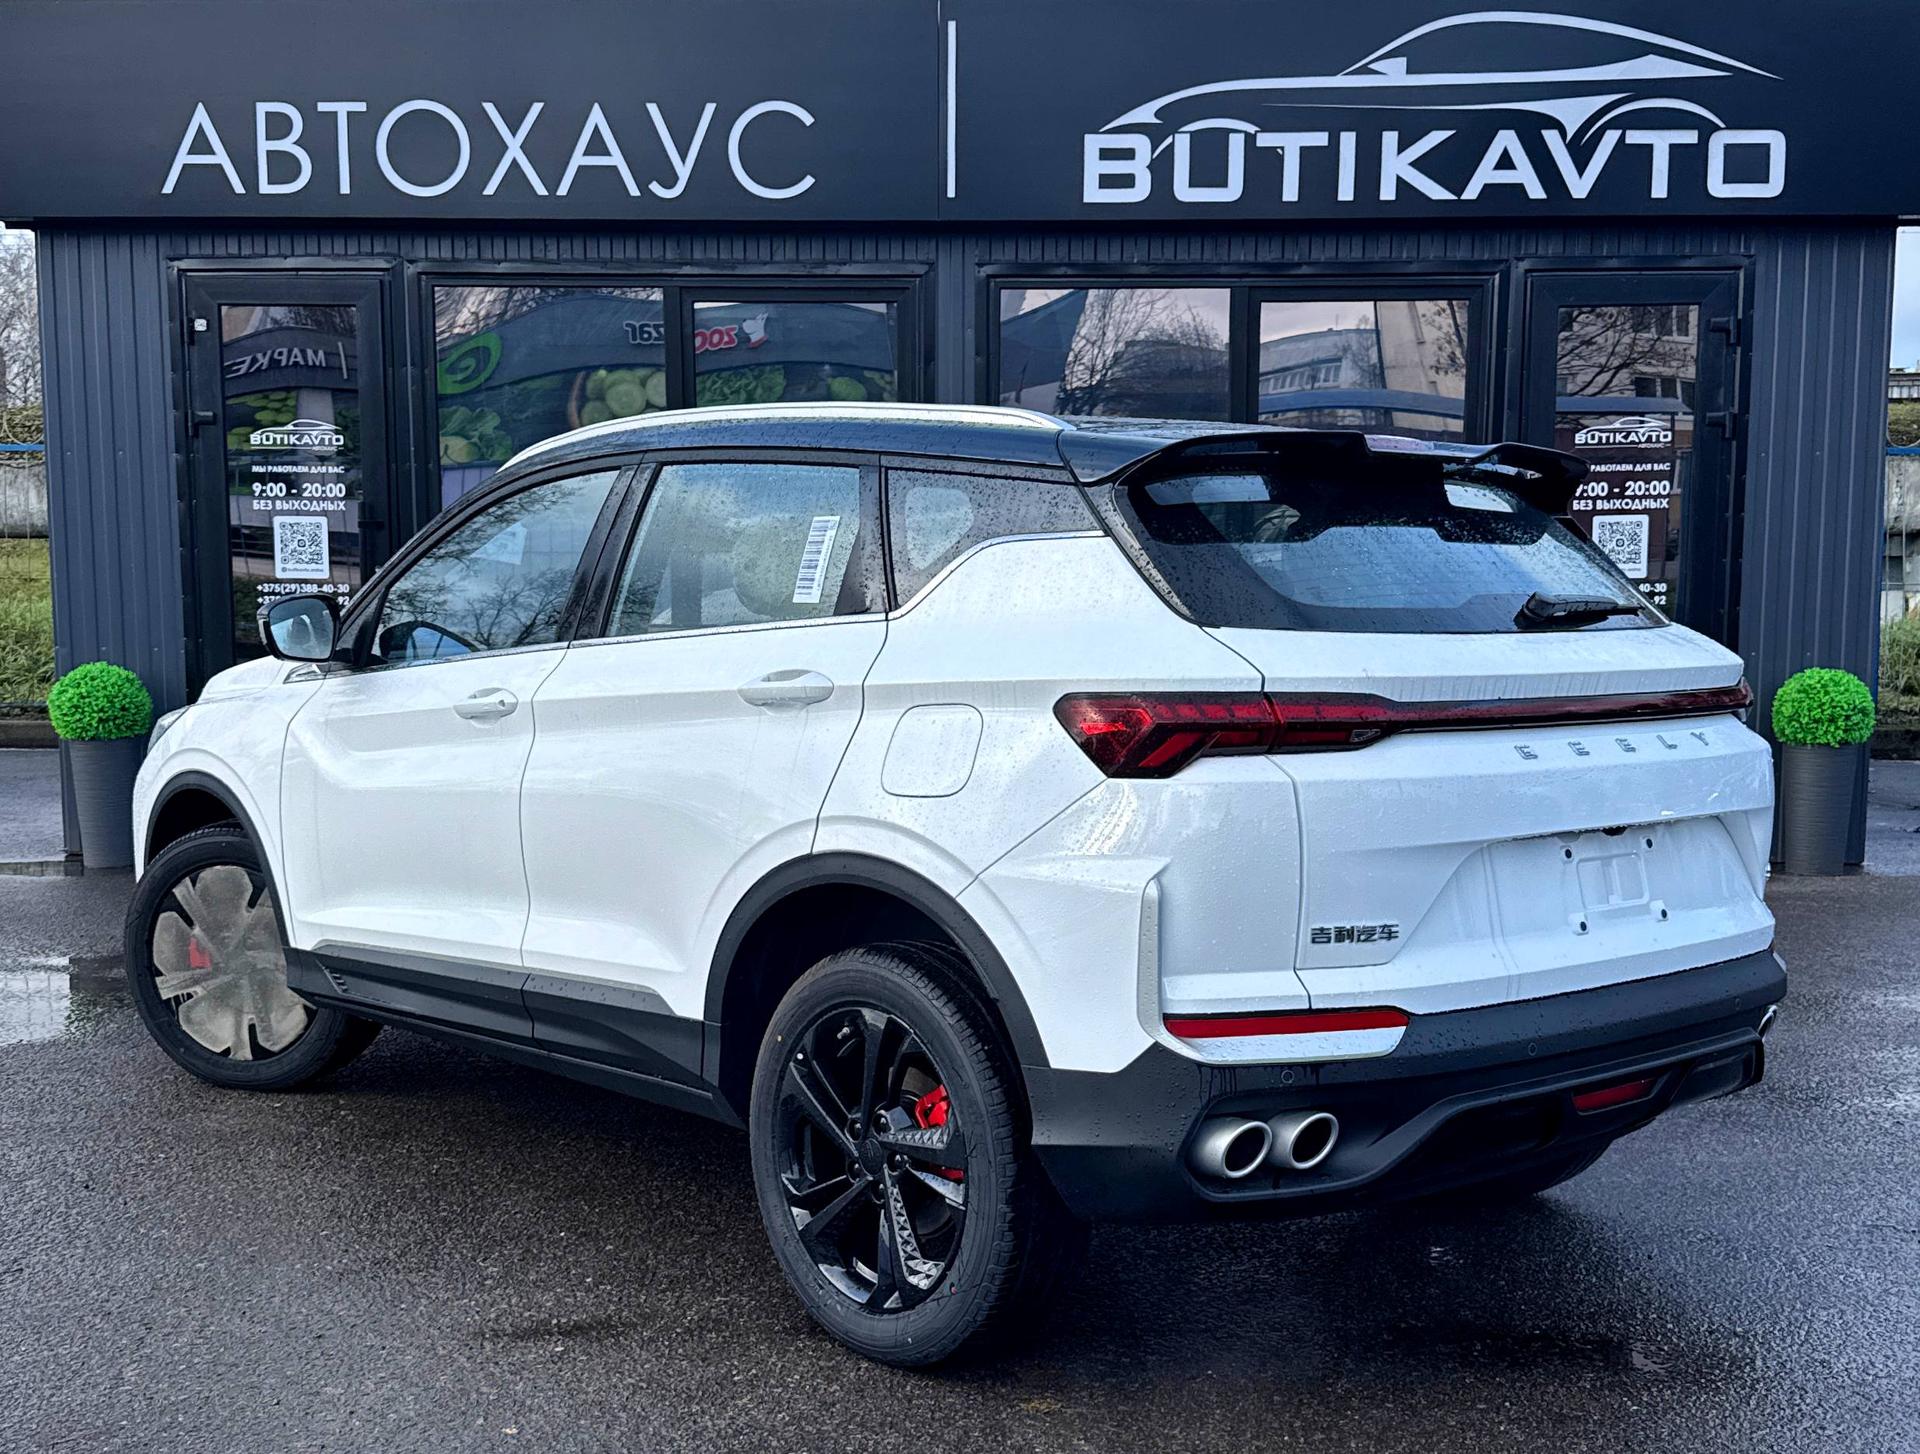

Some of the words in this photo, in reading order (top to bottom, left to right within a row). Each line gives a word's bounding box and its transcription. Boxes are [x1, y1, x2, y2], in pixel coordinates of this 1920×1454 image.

[161, 99, 816, 200] АВТОХАУС
[1083, 129, 1786, 203] BUTIKAVTO
[250, 432, 345, 446] BUTIKAVTO
[1574, 430, 1672, 445] BUTIKAVTO
[252, 465, 266, 473] МЫ
[268, 465, 309, 473] РАБОТАЕМ
[310, 466, 327, 474] ДЛЯ
[328, 466, 345, 474] ВАС
[1590, 463, 1633, 473] РАБОТАЕМ
[1634, 463, 1652, 472] ДЛЯ
[1653, 462, 1671, 471] ВАС
[252, 482, 287, 498] 9:00
[302, 482, 346, 498] 20:00
[1624, 480, 1671, 496] 20:00
[253, 499, 273, 510] БЕЗ
[275, 499, 346, 512] ВЫХОДНЫХ
[1572, 499, 1594, 511] БЕЗ
[1595, 497, 1670, 511] ВЫХОДНЫХ
[256, 582, 350, 595] +375(29)388-40-30
[1310, 923, 1400, 945] 吉利汽车
